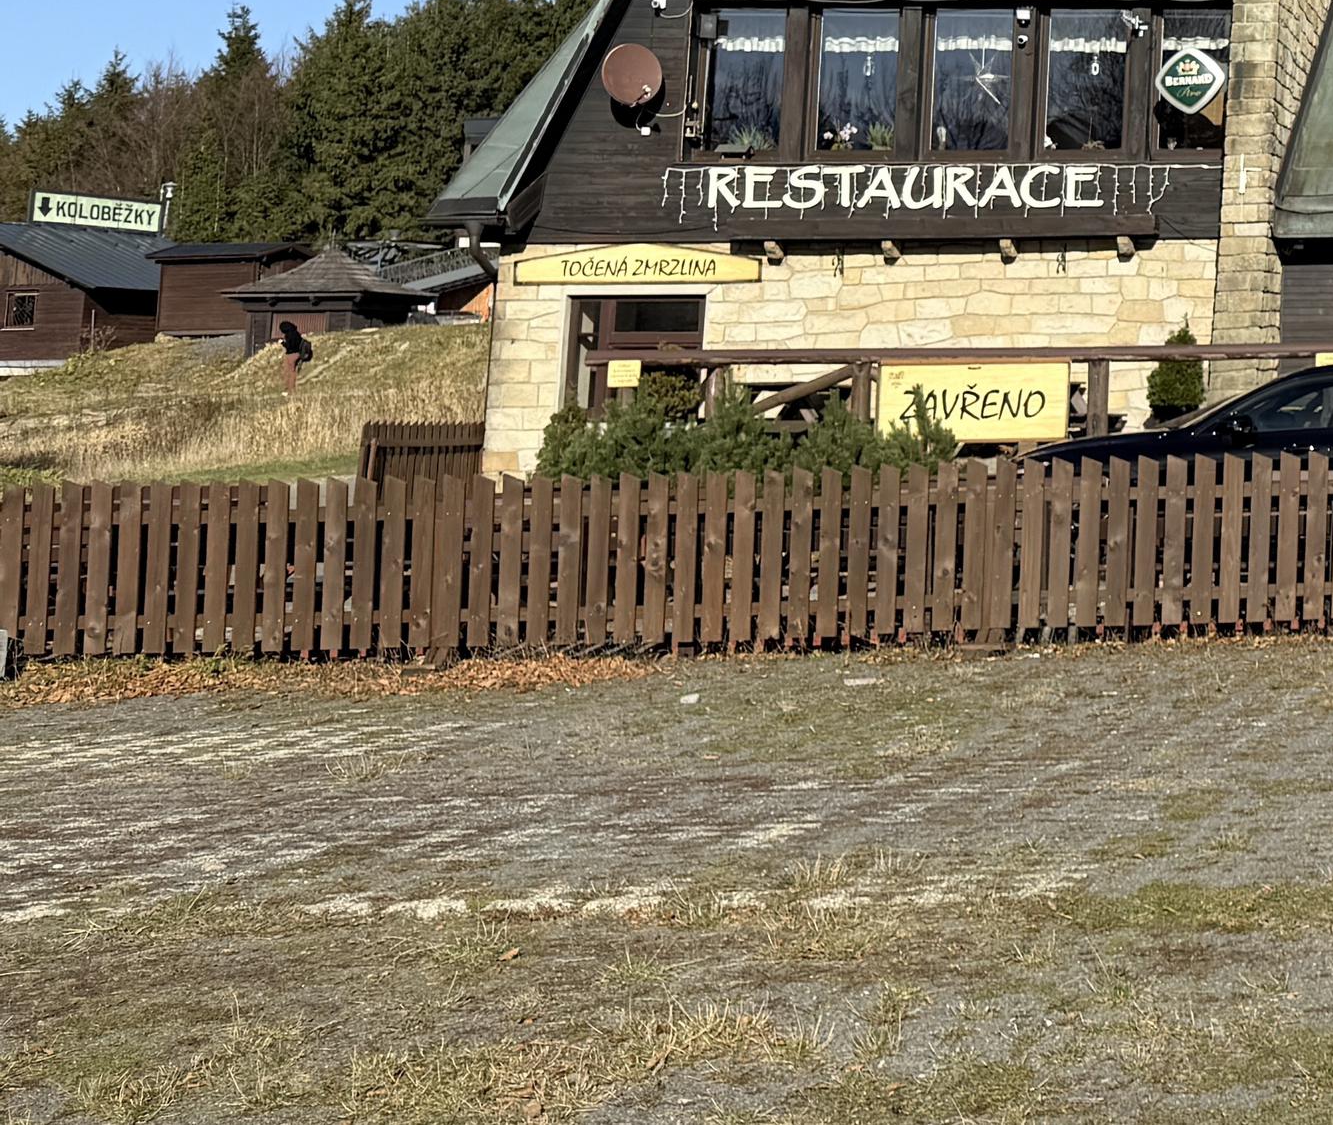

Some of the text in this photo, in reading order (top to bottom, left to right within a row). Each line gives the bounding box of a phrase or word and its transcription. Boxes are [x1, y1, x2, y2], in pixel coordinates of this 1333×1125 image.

[1164, 73, 1214, 87] BERNARD
[707, 165, 1104, 210] RESTAURACE
[56, 200, 156, 226] KOLOBĚŽKY
[561, 256, 717, 277] TOČENÁ ZMRZLINA
[899, 383, 1046, 421] ZAVŘENO
